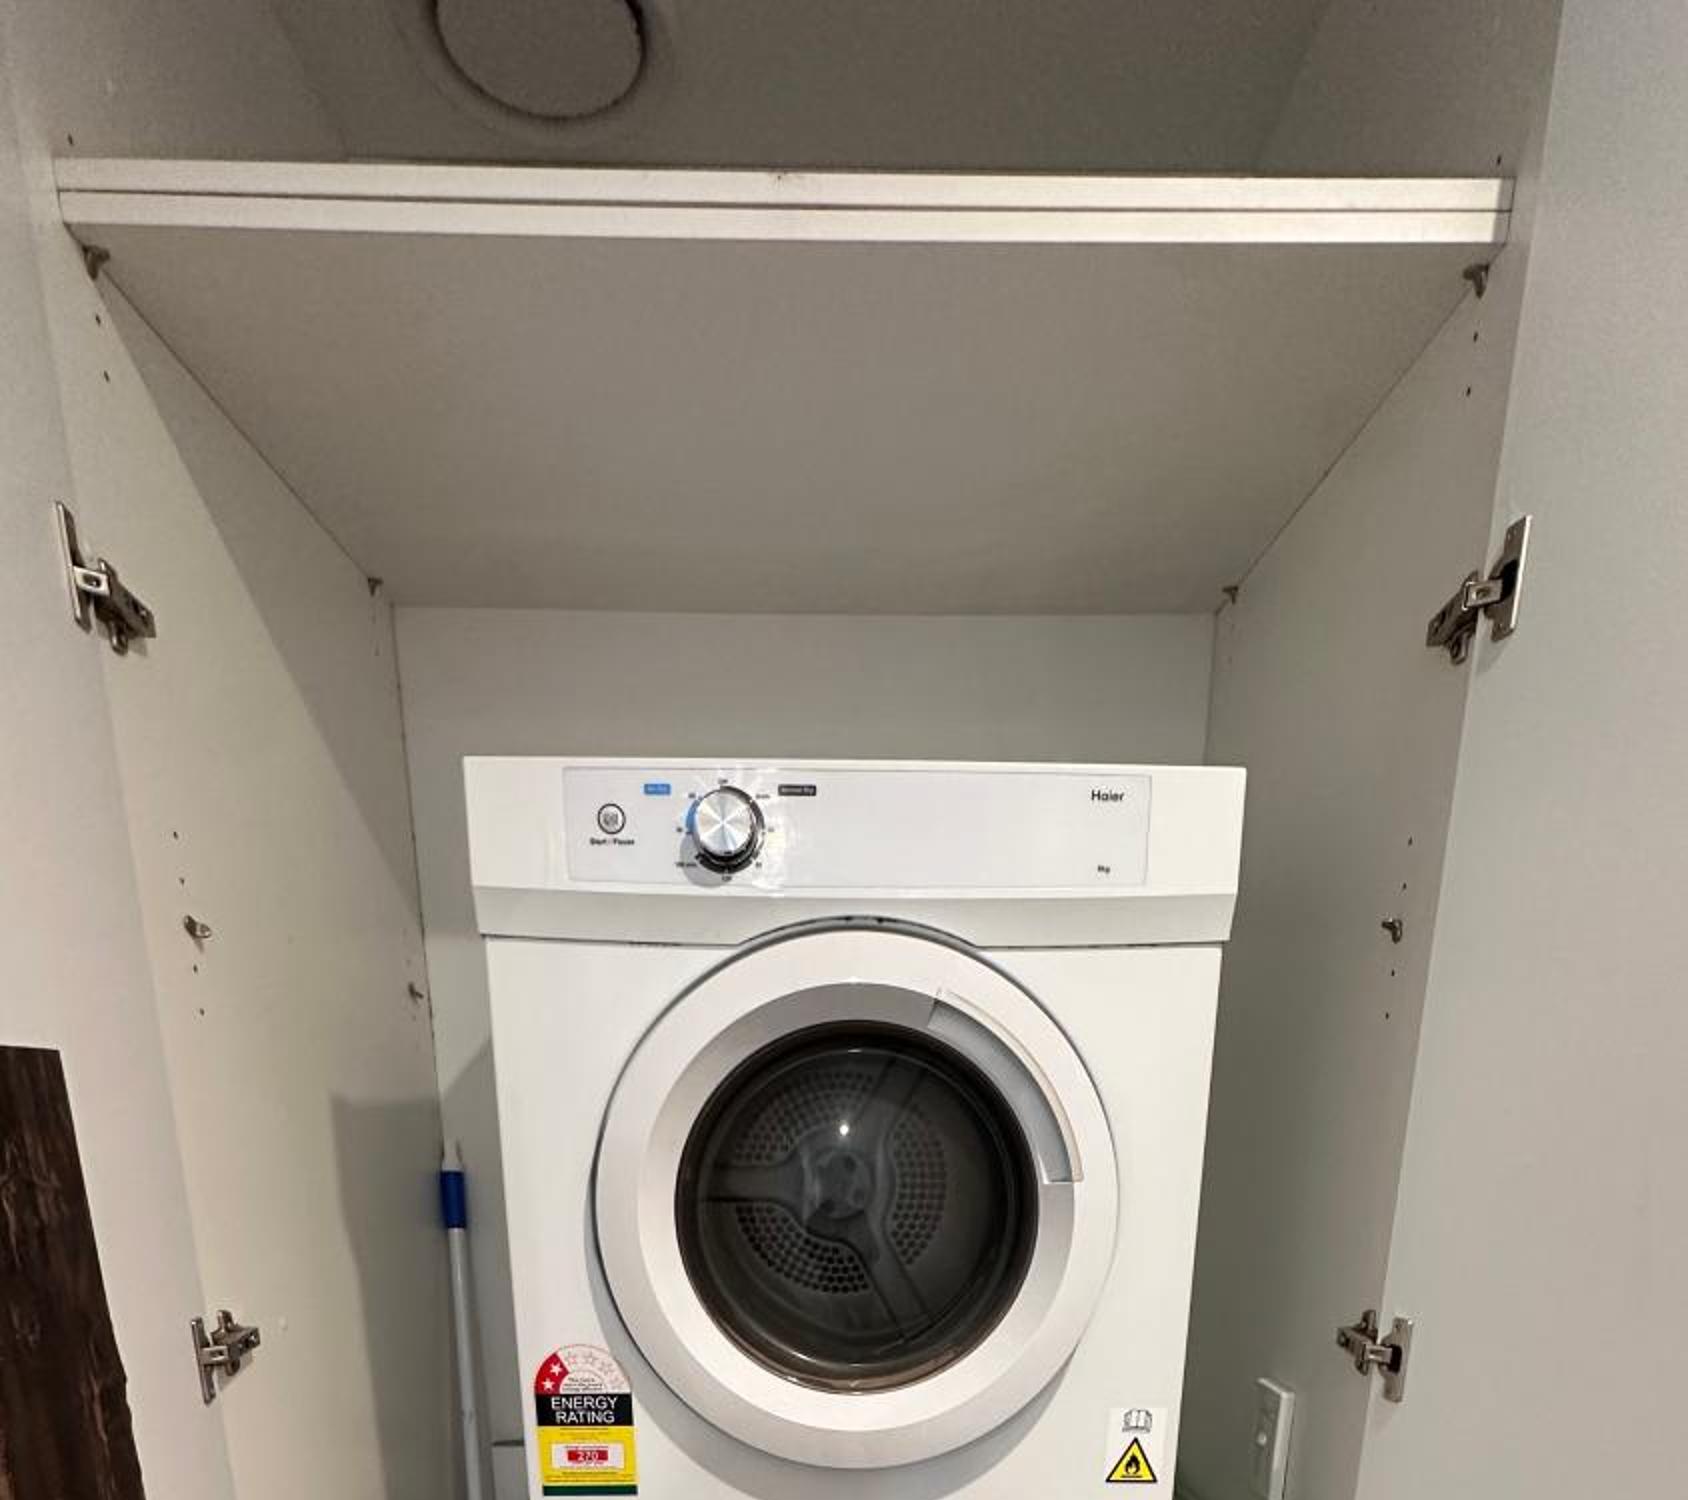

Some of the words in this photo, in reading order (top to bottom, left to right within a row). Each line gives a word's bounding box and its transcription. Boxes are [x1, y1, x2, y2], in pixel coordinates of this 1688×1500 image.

[1091, 789, 1125, 802] Haier
[551, 1396, 618, 1410] ENERGY
[555, 1411, 615, 1424] RATING
[576, 1451, 600, 1462] 270
